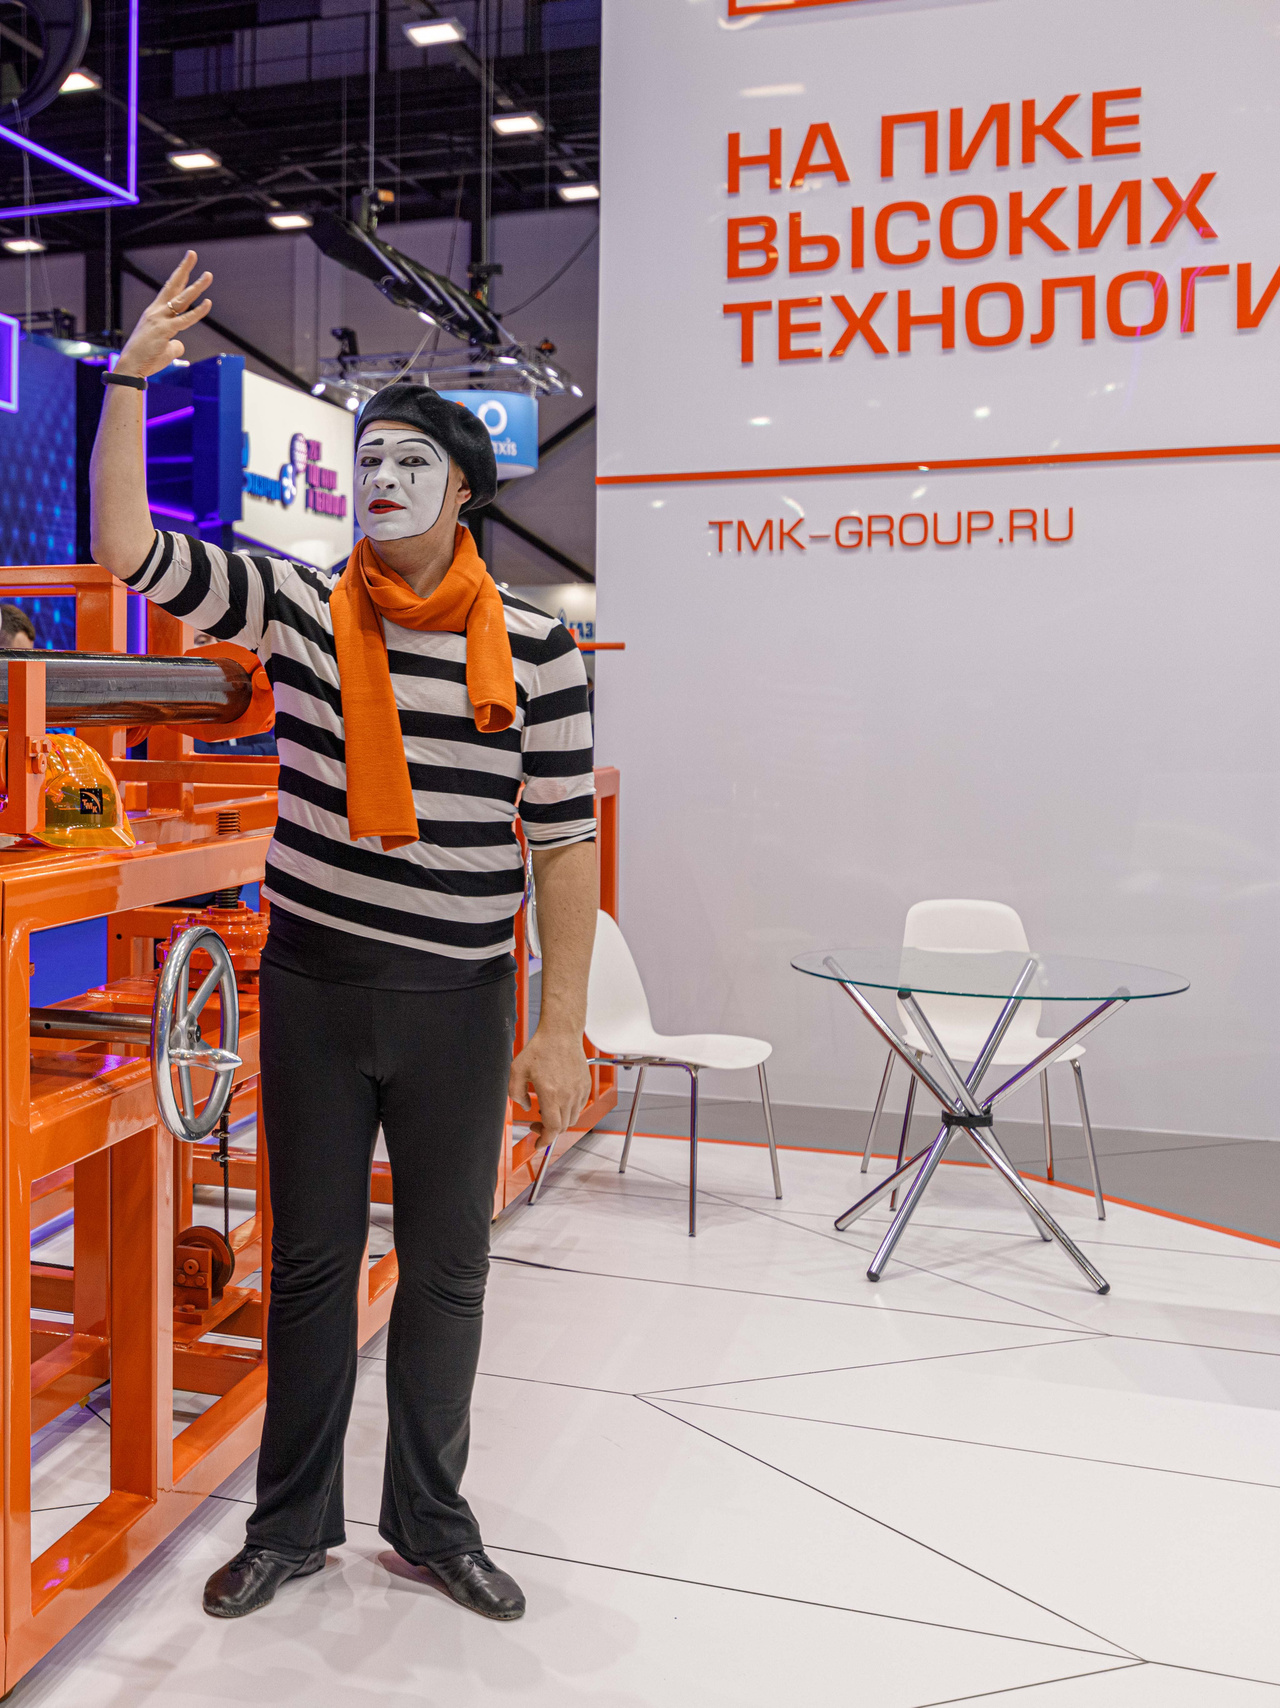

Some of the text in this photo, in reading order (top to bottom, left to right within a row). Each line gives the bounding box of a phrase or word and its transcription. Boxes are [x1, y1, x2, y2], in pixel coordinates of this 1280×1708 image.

[728, 88, 1141, 193] НА ПИКЕ
[727, 173, 1218, 279] ВЫСОКИХ
[708, 508, 1075, 553] TMK-GROUP.RU
